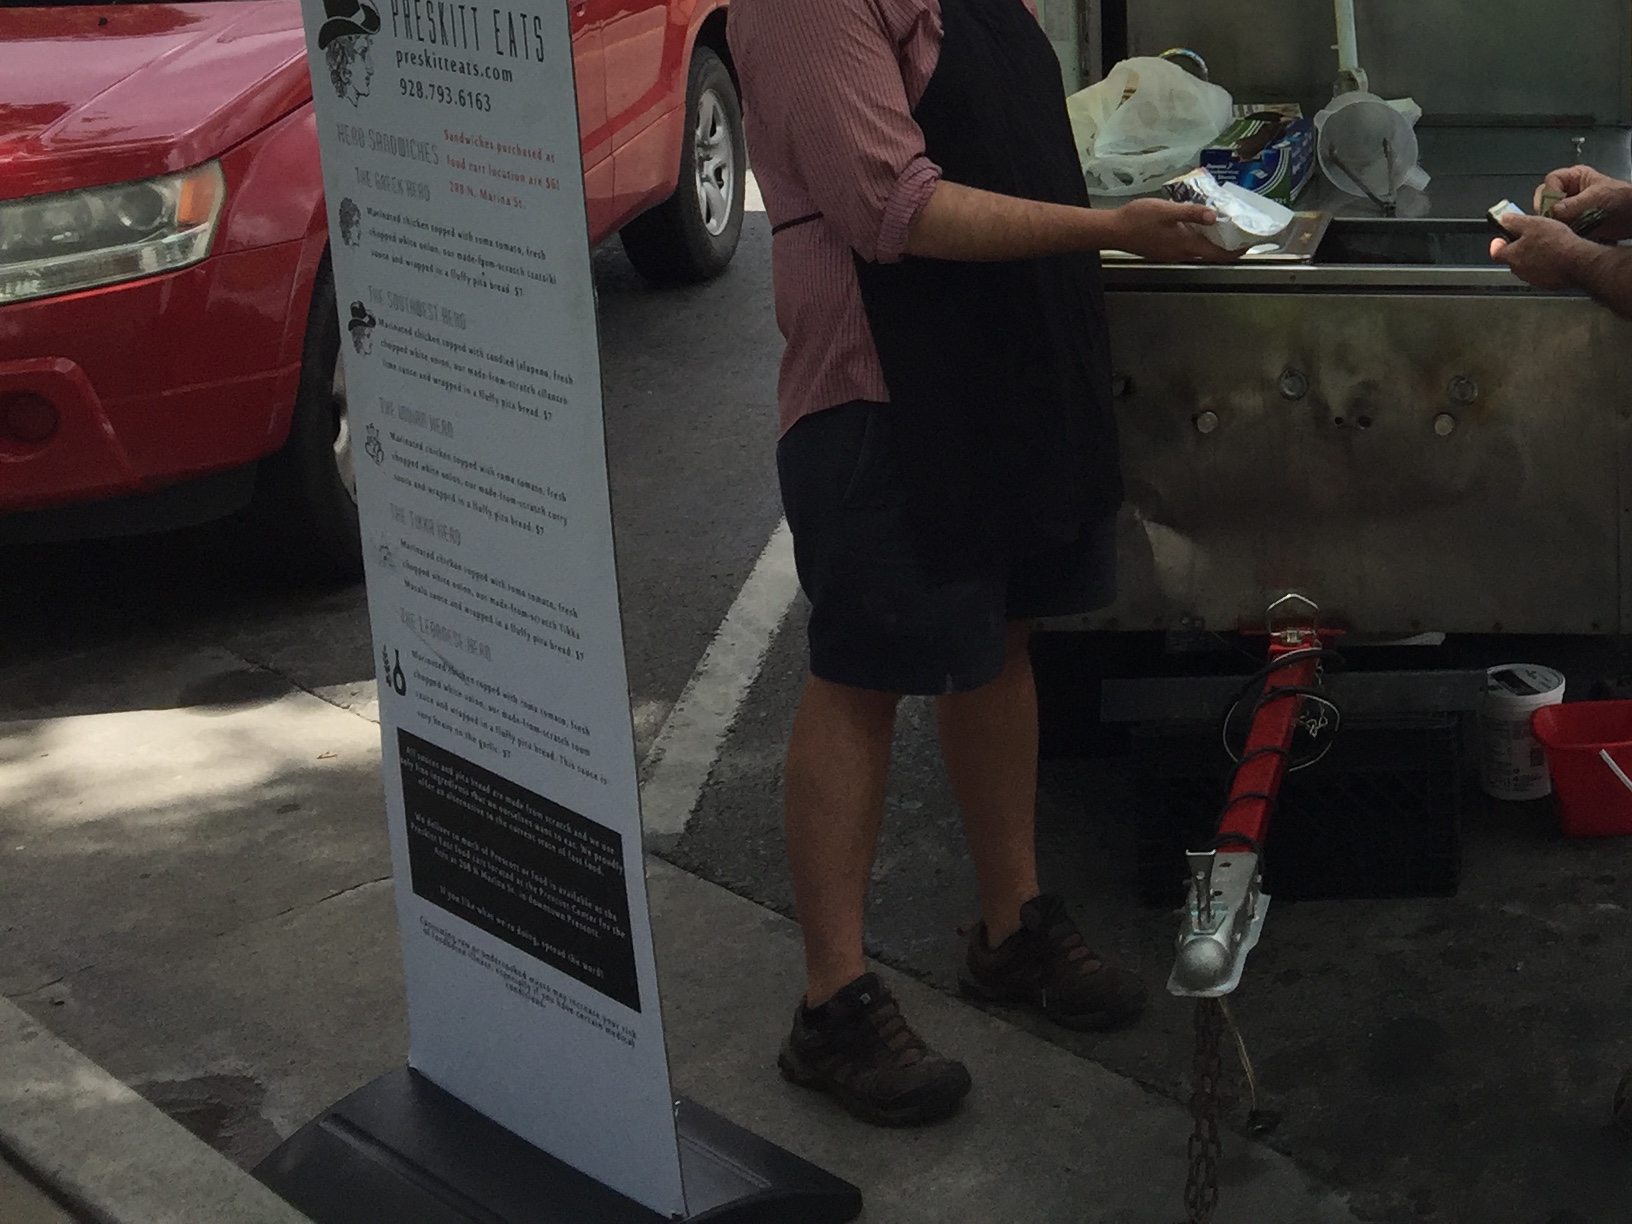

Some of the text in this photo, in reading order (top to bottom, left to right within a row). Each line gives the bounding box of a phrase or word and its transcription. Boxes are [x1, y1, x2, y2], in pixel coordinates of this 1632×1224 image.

[492, 8, 544, 63] EATS
[395, 50, 513, 82] preskitteats.com
[399, 77, 491, 112] 928.793.6163
[443, 128, 494, 150] Sandwiches
[496, 141, 542, 161] purchased
